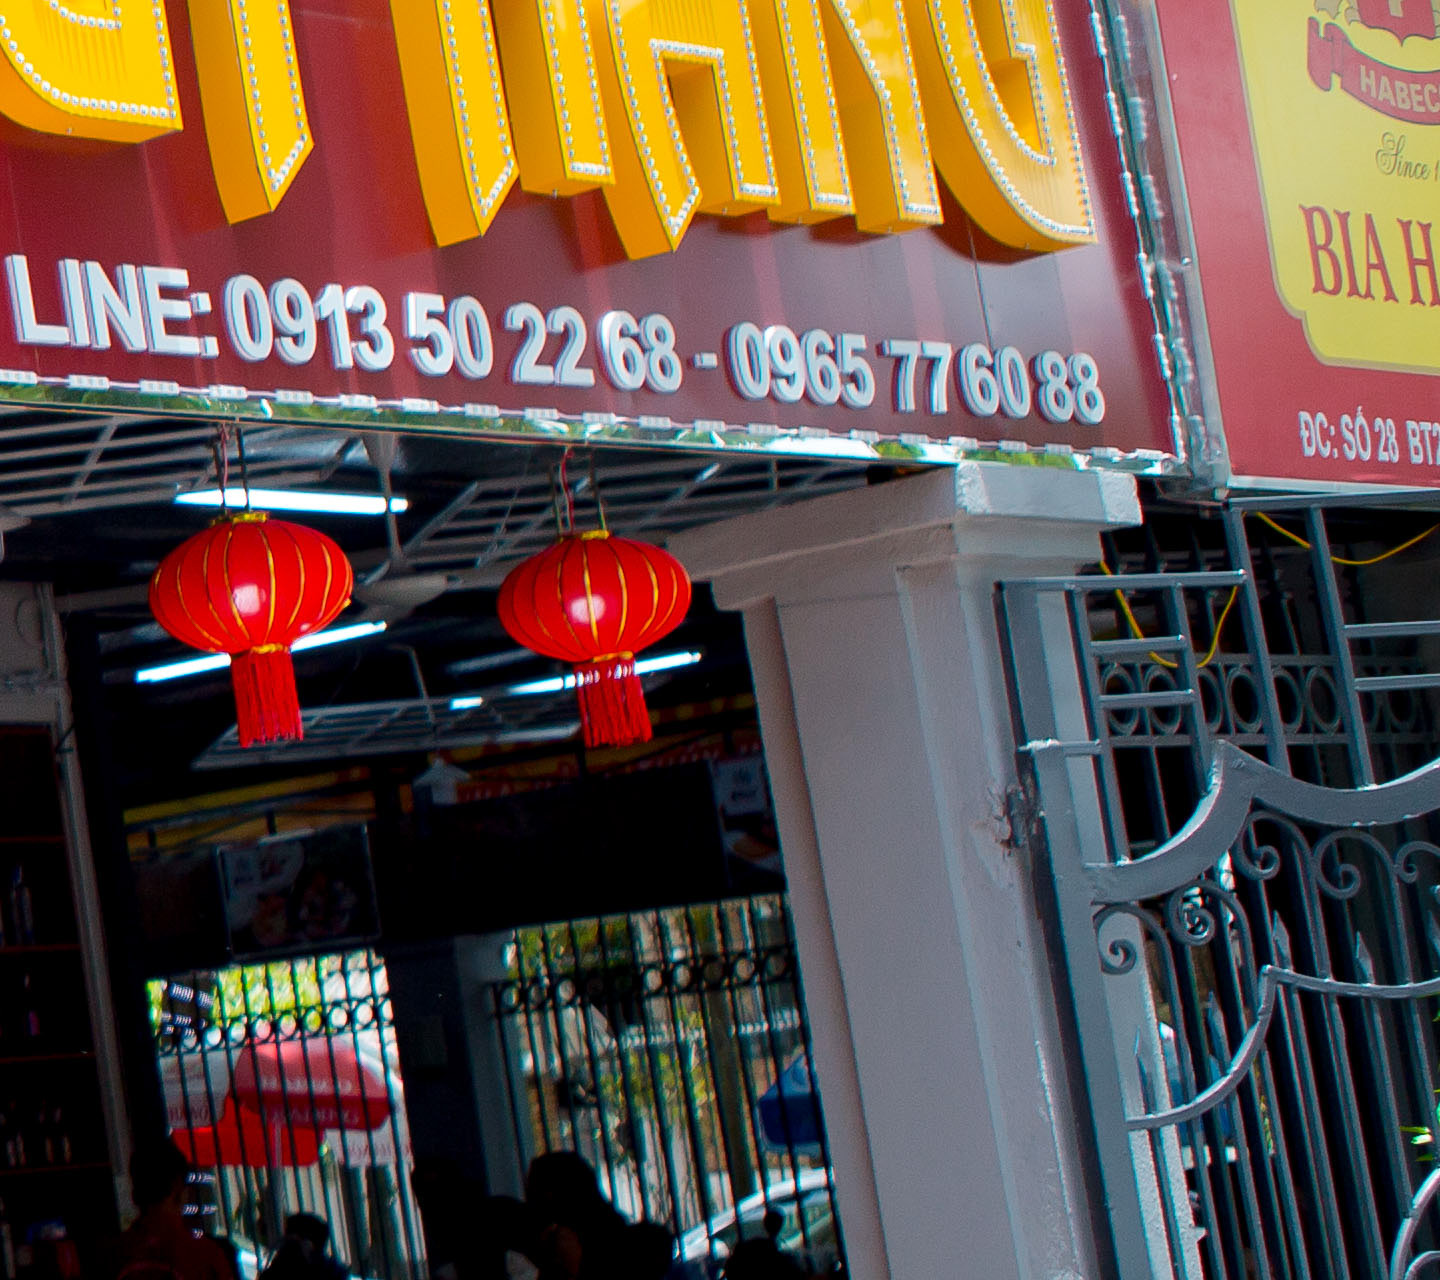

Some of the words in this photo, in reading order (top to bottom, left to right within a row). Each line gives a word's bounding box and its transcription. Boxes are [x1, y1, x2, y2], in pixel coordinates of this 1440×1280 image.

[1375, 131, 1431, 181] Since
[1299, 203, 1400, 305] BIA
[5, 253, 220, 359] LINE:
[224, 273, 395, 373] 0913
[404, 291, 494, 380] 50
[503, 301, 596, 388] 22
[600, 308, 683, 395] 68
[728, 321, 876, 409] 0965
[1298, 409, 1339, 460] ĐC:
[1373, 416, 1400, 464] 28
